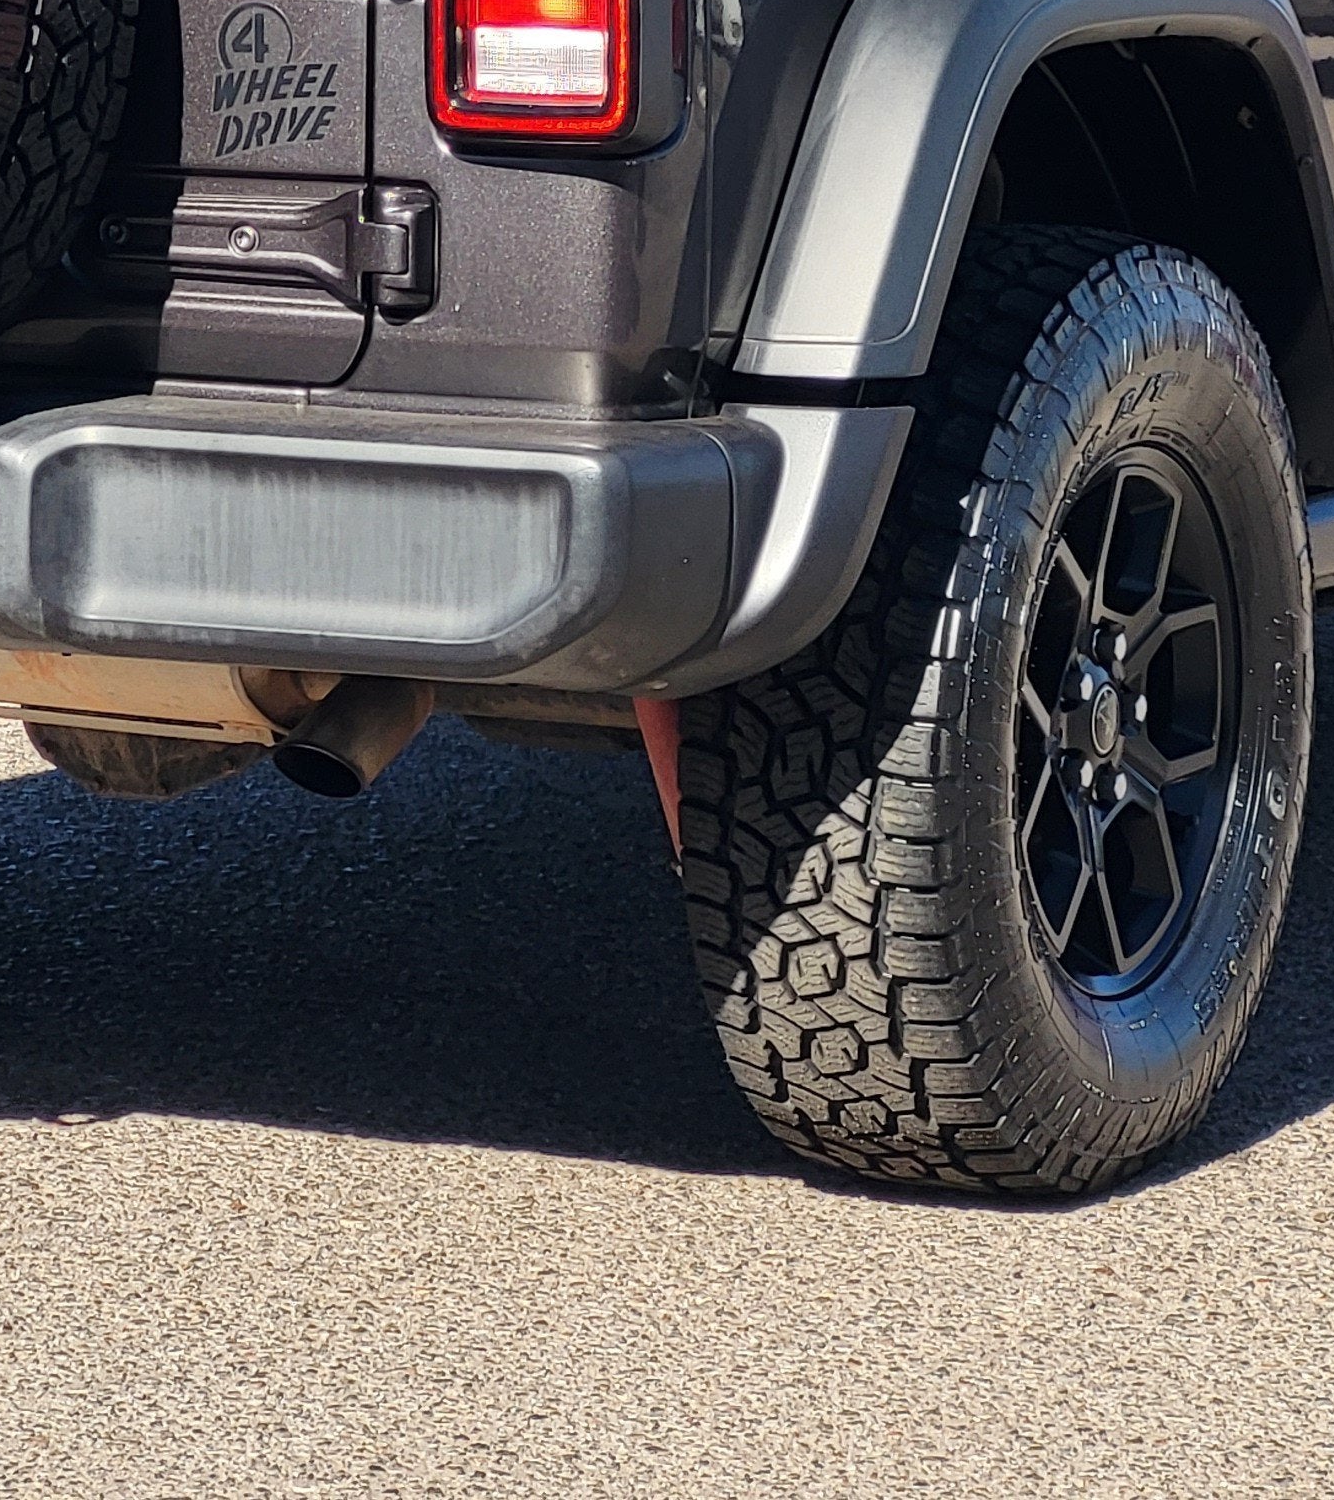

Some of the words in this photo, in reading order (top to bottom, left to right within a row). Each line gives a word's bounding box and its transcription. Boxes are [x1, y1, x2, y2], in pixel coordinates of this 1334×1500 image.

[231, 12, 269, 64] 4
[212, 63, 339, 113] WHEEL
[215, 105, 337, 158] DRIVE
